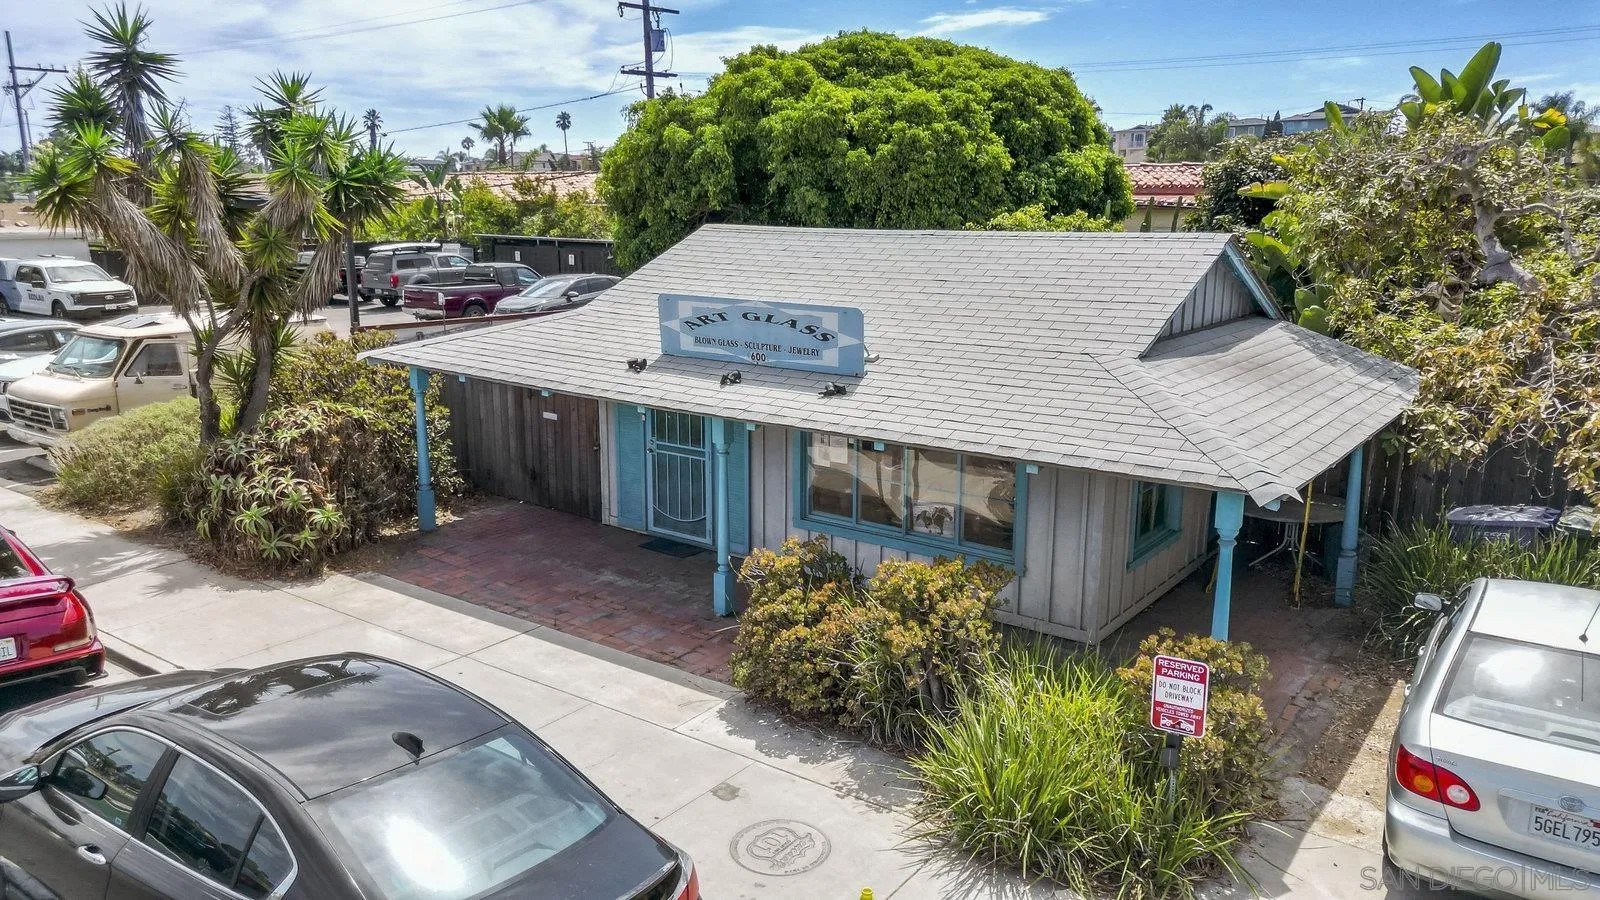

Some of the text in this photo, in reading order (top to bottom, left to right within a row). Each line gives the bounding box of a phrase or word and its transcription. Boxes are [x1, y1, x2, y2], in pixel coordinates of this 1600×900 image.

[684, 311, 836, 342] ART GLASS
[694, 336, 820, 357] BLOWN GLASS SCULPTURE JEWELRY
[751, 352, 766, 362] 600
[1158, 658, 1205, 674] RESERVED
[1161, 667, 1201, 681] PARKING
[1158, 680, 1202, 696] DO NOT BLOCK
[1164, 690, 1194, 703] DRIVEWAY
[1534, 815, 1600, 847] 5GEL795
